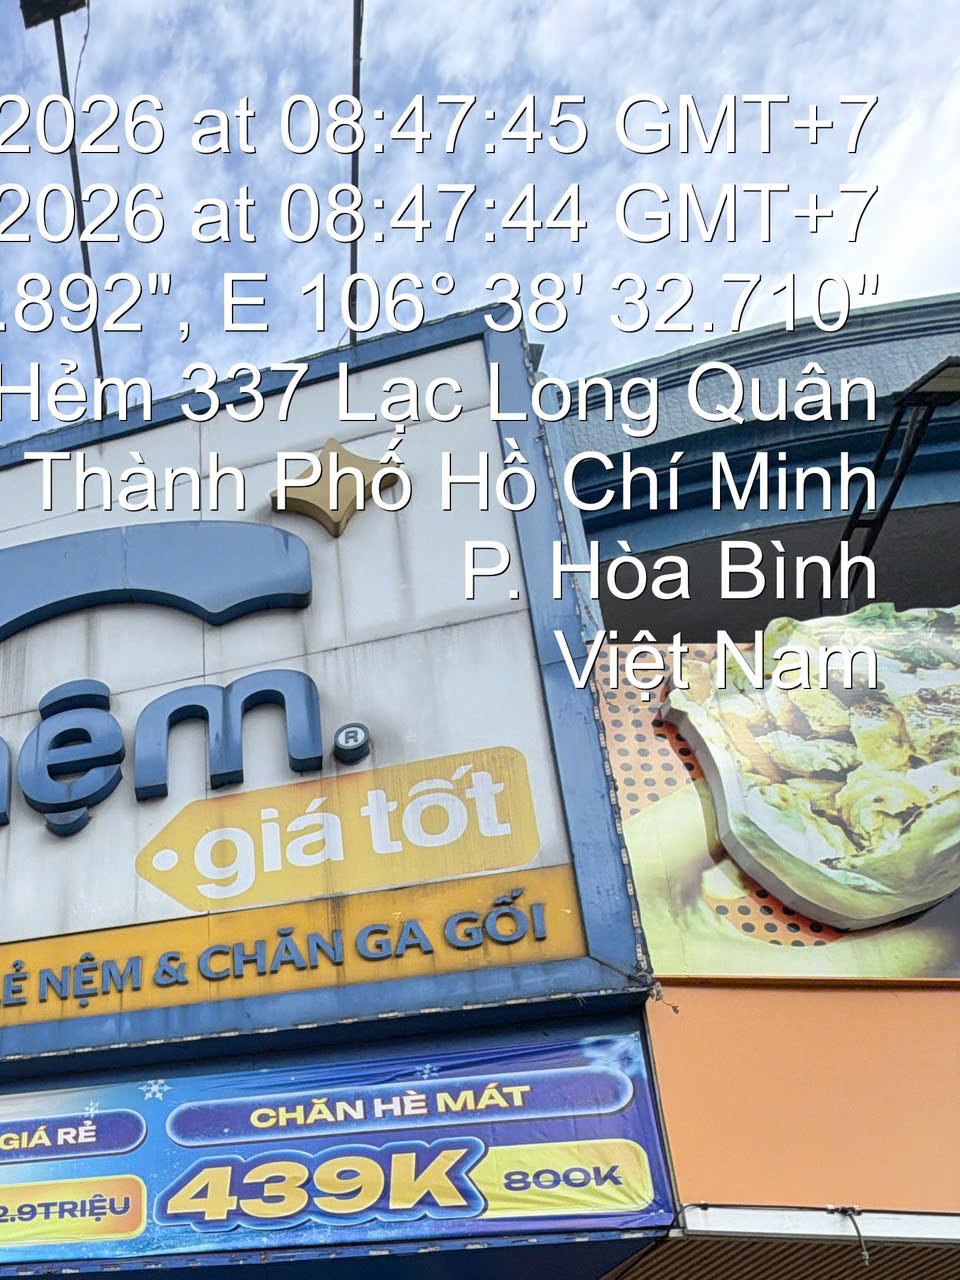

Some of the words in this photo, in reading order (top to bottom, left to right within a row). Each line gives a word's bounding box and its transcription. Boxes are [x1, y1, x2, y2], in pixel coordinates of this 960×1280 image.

[193, 796, 345, 900] giá
[360, 763, 512, 856] tốt
[39, 951, 142, 1009] NỆM
[152, 950, 189, 988] &
[197, 927, 345, 983] CHĂN
[355, 921, 434, 962] GA
[444, 887, 548, 951] GỐI
[56, 1119, 98, 1145] RẺ
[250, 1098, 362, 1129] CHĂN
[375, 1089, 427, 1118] HÈ
[437, 1081, 532, 1113] MÁT
[166, 1146, 475, 1221] 439K
[502, 1164, 624, 1192] 800K
